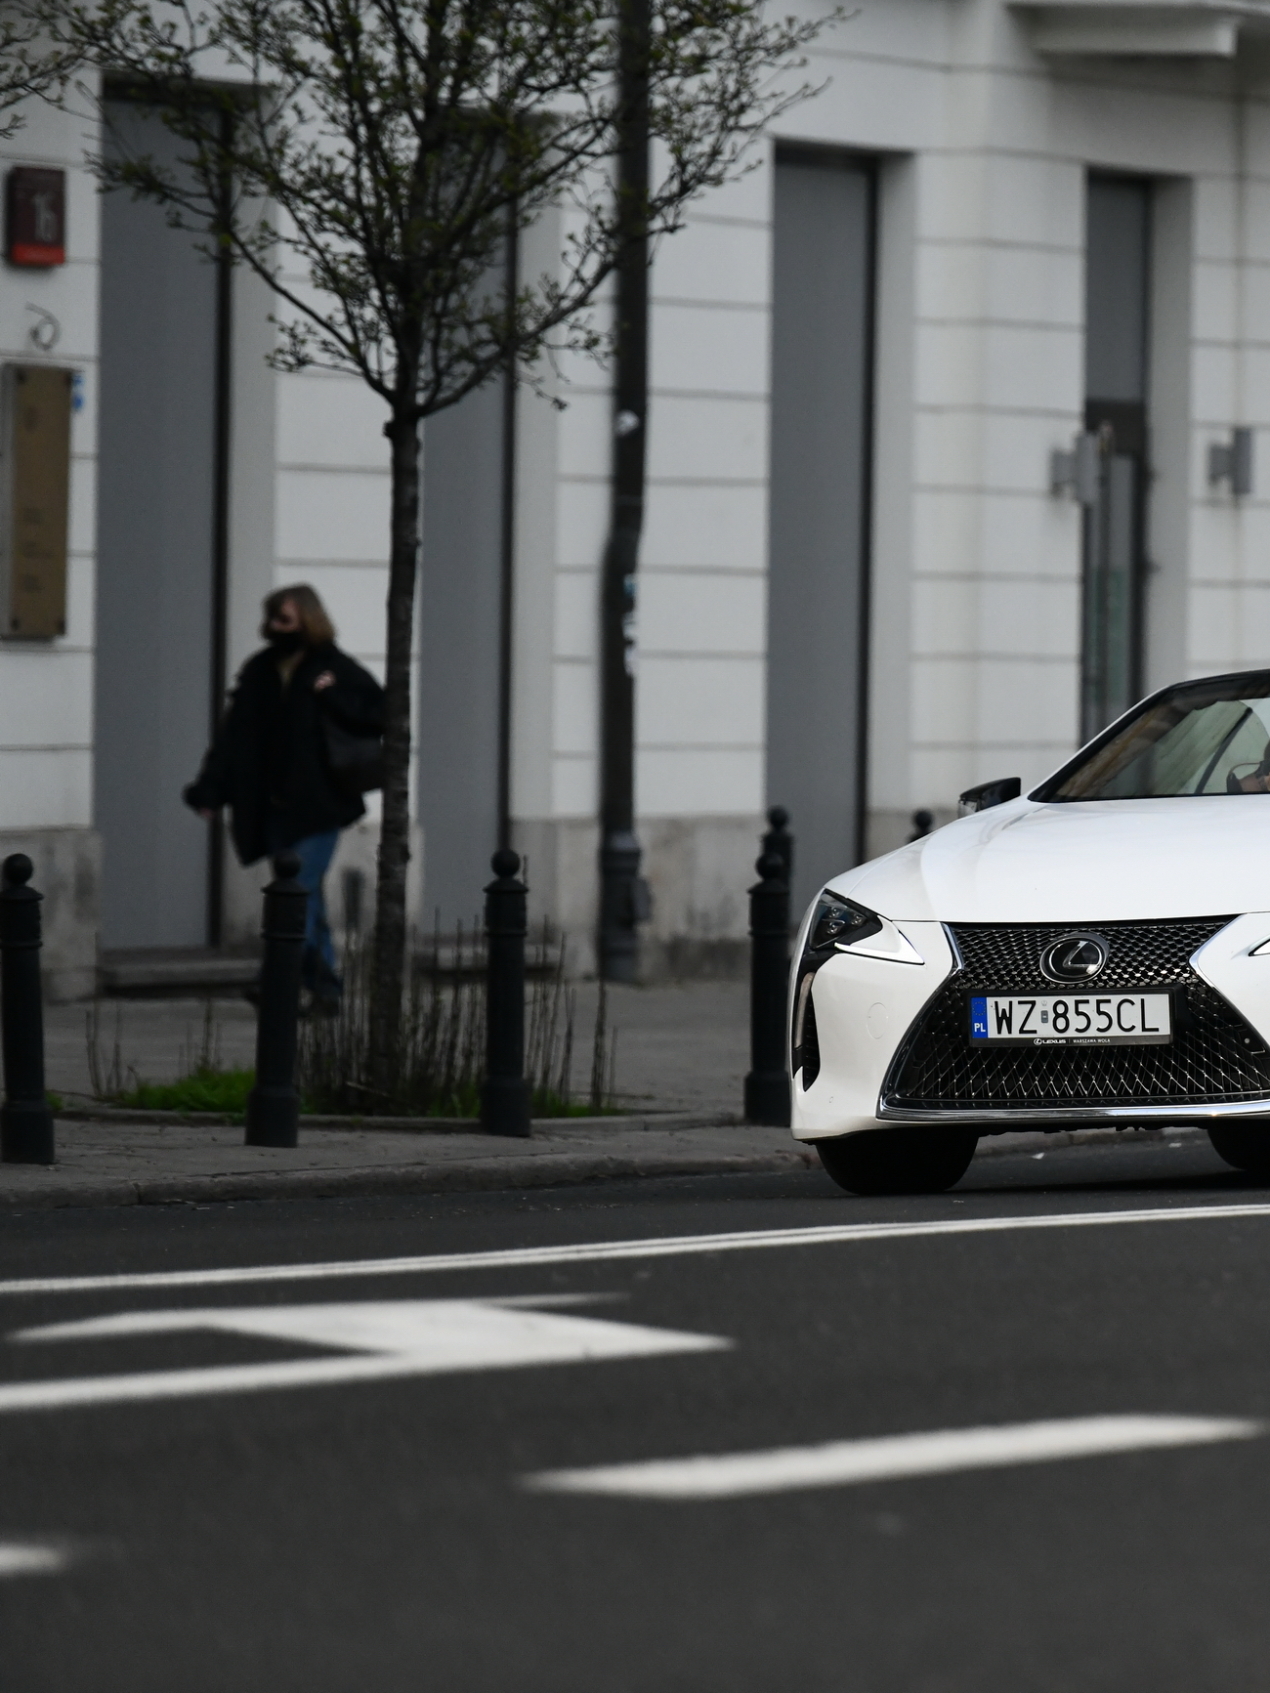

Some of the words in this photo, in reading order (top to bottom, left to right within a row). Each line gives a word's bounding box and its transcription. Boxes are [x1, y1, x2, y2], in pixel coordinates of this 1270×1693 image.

[974, 1023, 986, 1033] PL
[994, 1000, 1037, 1035] WZ
[1052, 998, 1159, 1034] 855CL
